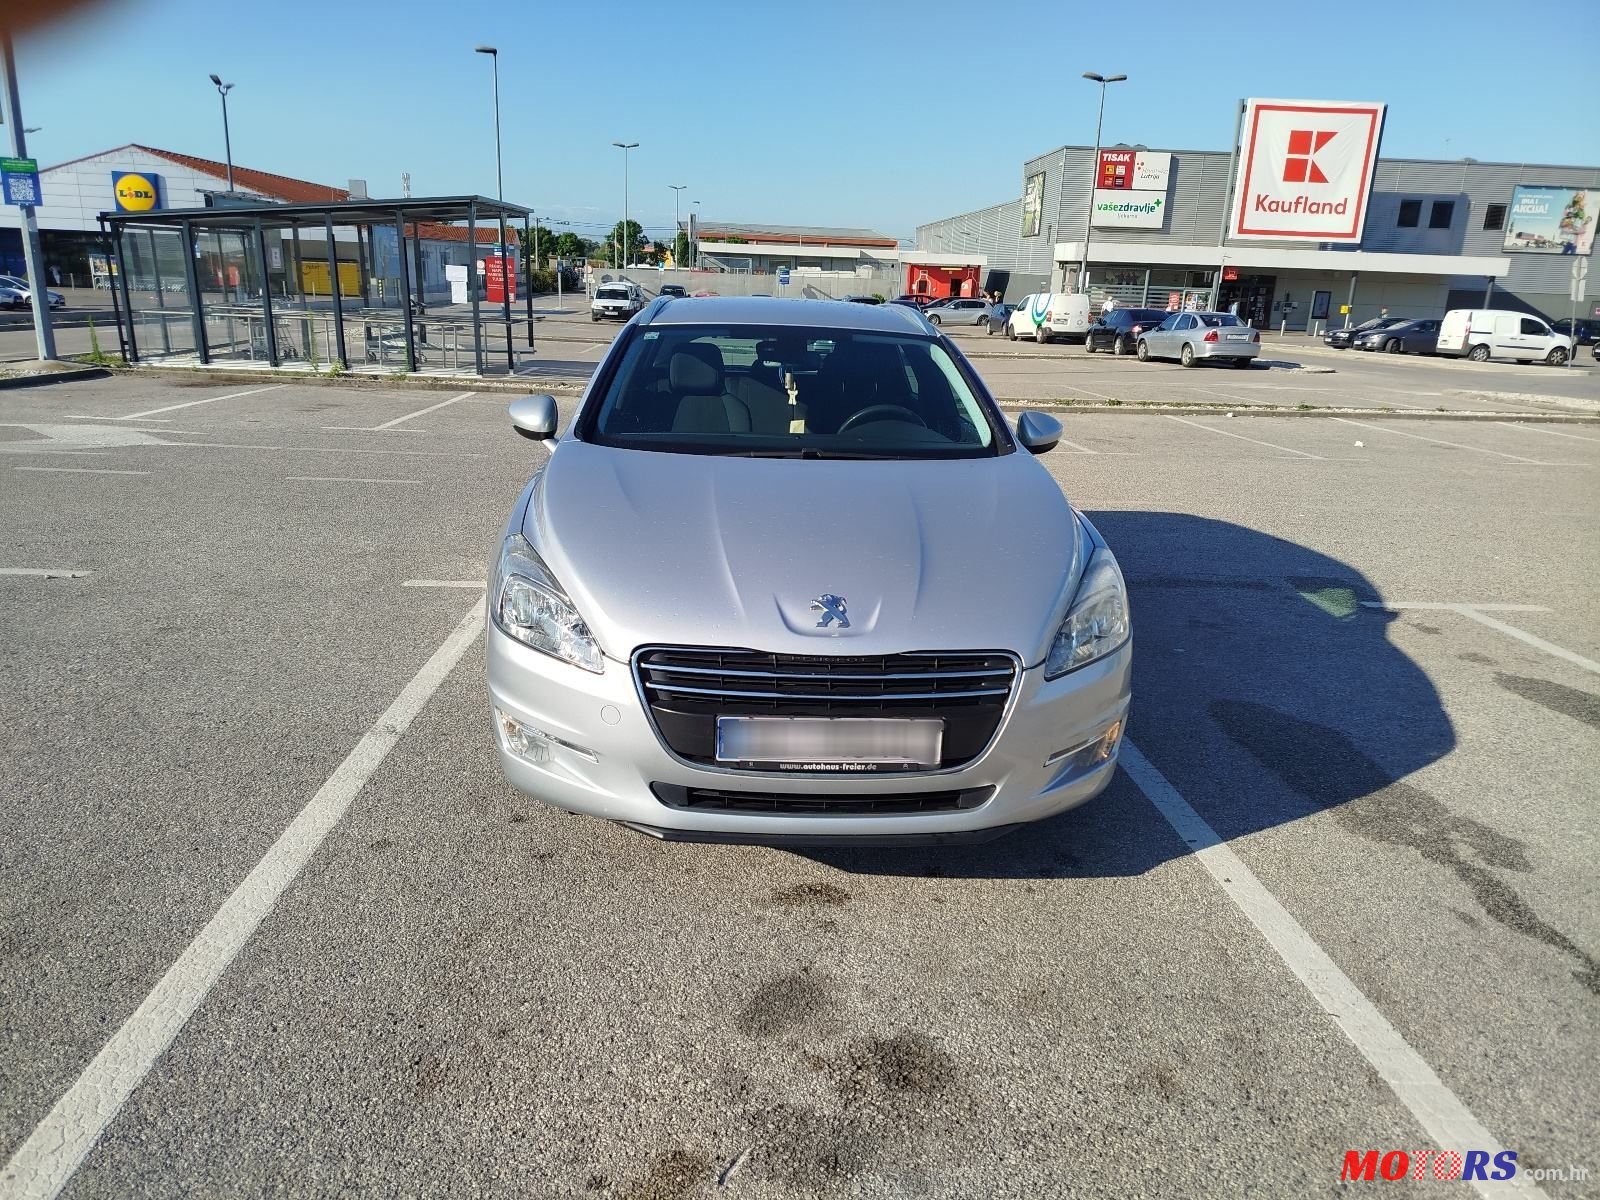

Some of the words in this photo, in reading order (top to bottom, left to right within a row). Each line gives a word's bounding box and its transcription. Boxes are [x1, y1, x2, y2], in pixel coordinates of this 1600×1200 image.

[1102, 153, 1131, 162] TISAK
[1255, 194, 1348, 215] Kaufland
[780, 762, 877, 771] www.autohaus-freier.de
